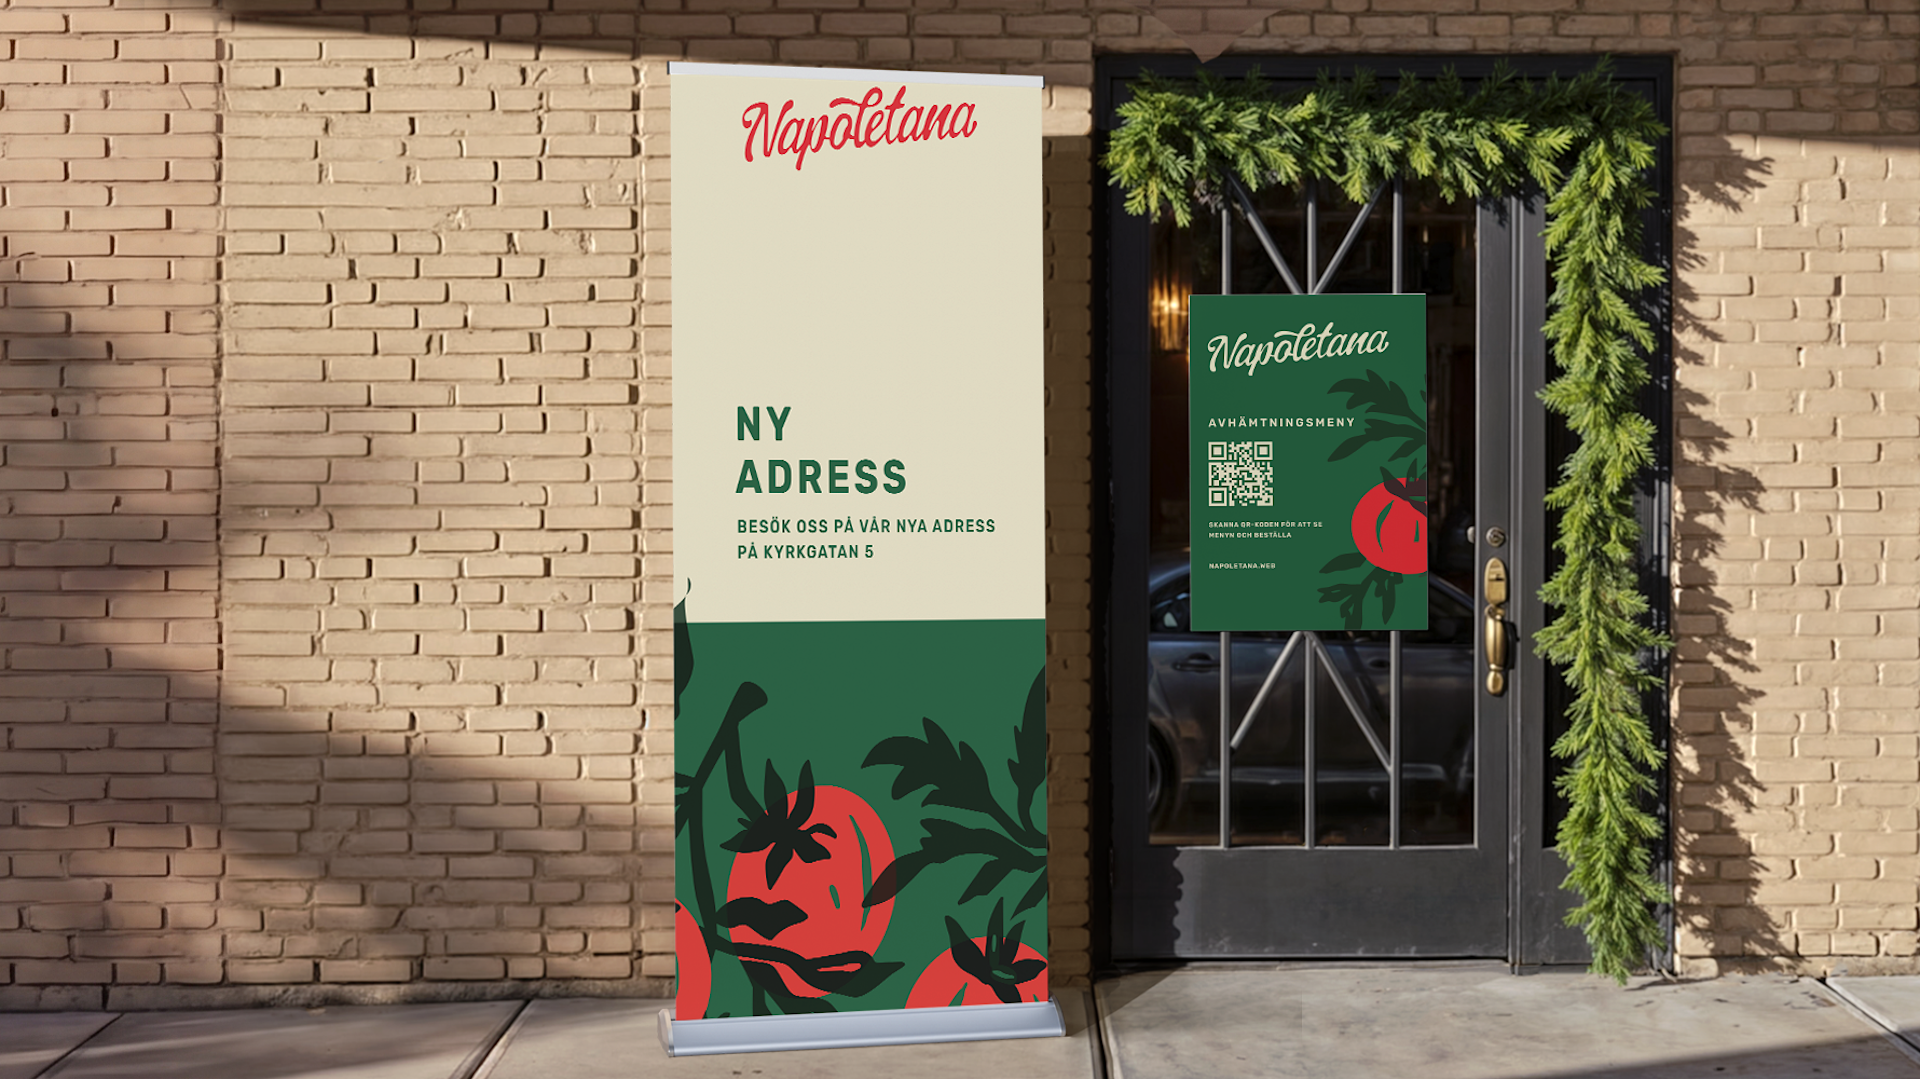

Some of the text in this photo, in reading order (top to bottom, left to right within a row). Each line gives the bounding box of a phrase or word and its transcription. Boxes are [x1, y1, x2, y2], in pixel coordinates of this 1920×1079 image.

[742, 85, 978, 171] Napoletana
[1207, 321, 1390, 376] Napoletana
[736, 405, 792, 441] NY
[1208, 415, 1355, 427] AVHÄMTNINGSMENY
[735, 458, 907, 494] ADRESS
[737, 515, 996, 534] BESÖK OSS PÅ VÅR NYA ADRESS
[1280, 519, 1296, 528] FÖR
[1297, 520, 1312, 528] ATT
[1313, 520, 1323, 528] SE
[1208, 530, 1292, 539] MENYN OCH BESTÄLLA
[737, 541, 874, 559] PÅ KYRKGATAN 5
[1208, 562, 1276, 570] NAPOLETANA.WEB
